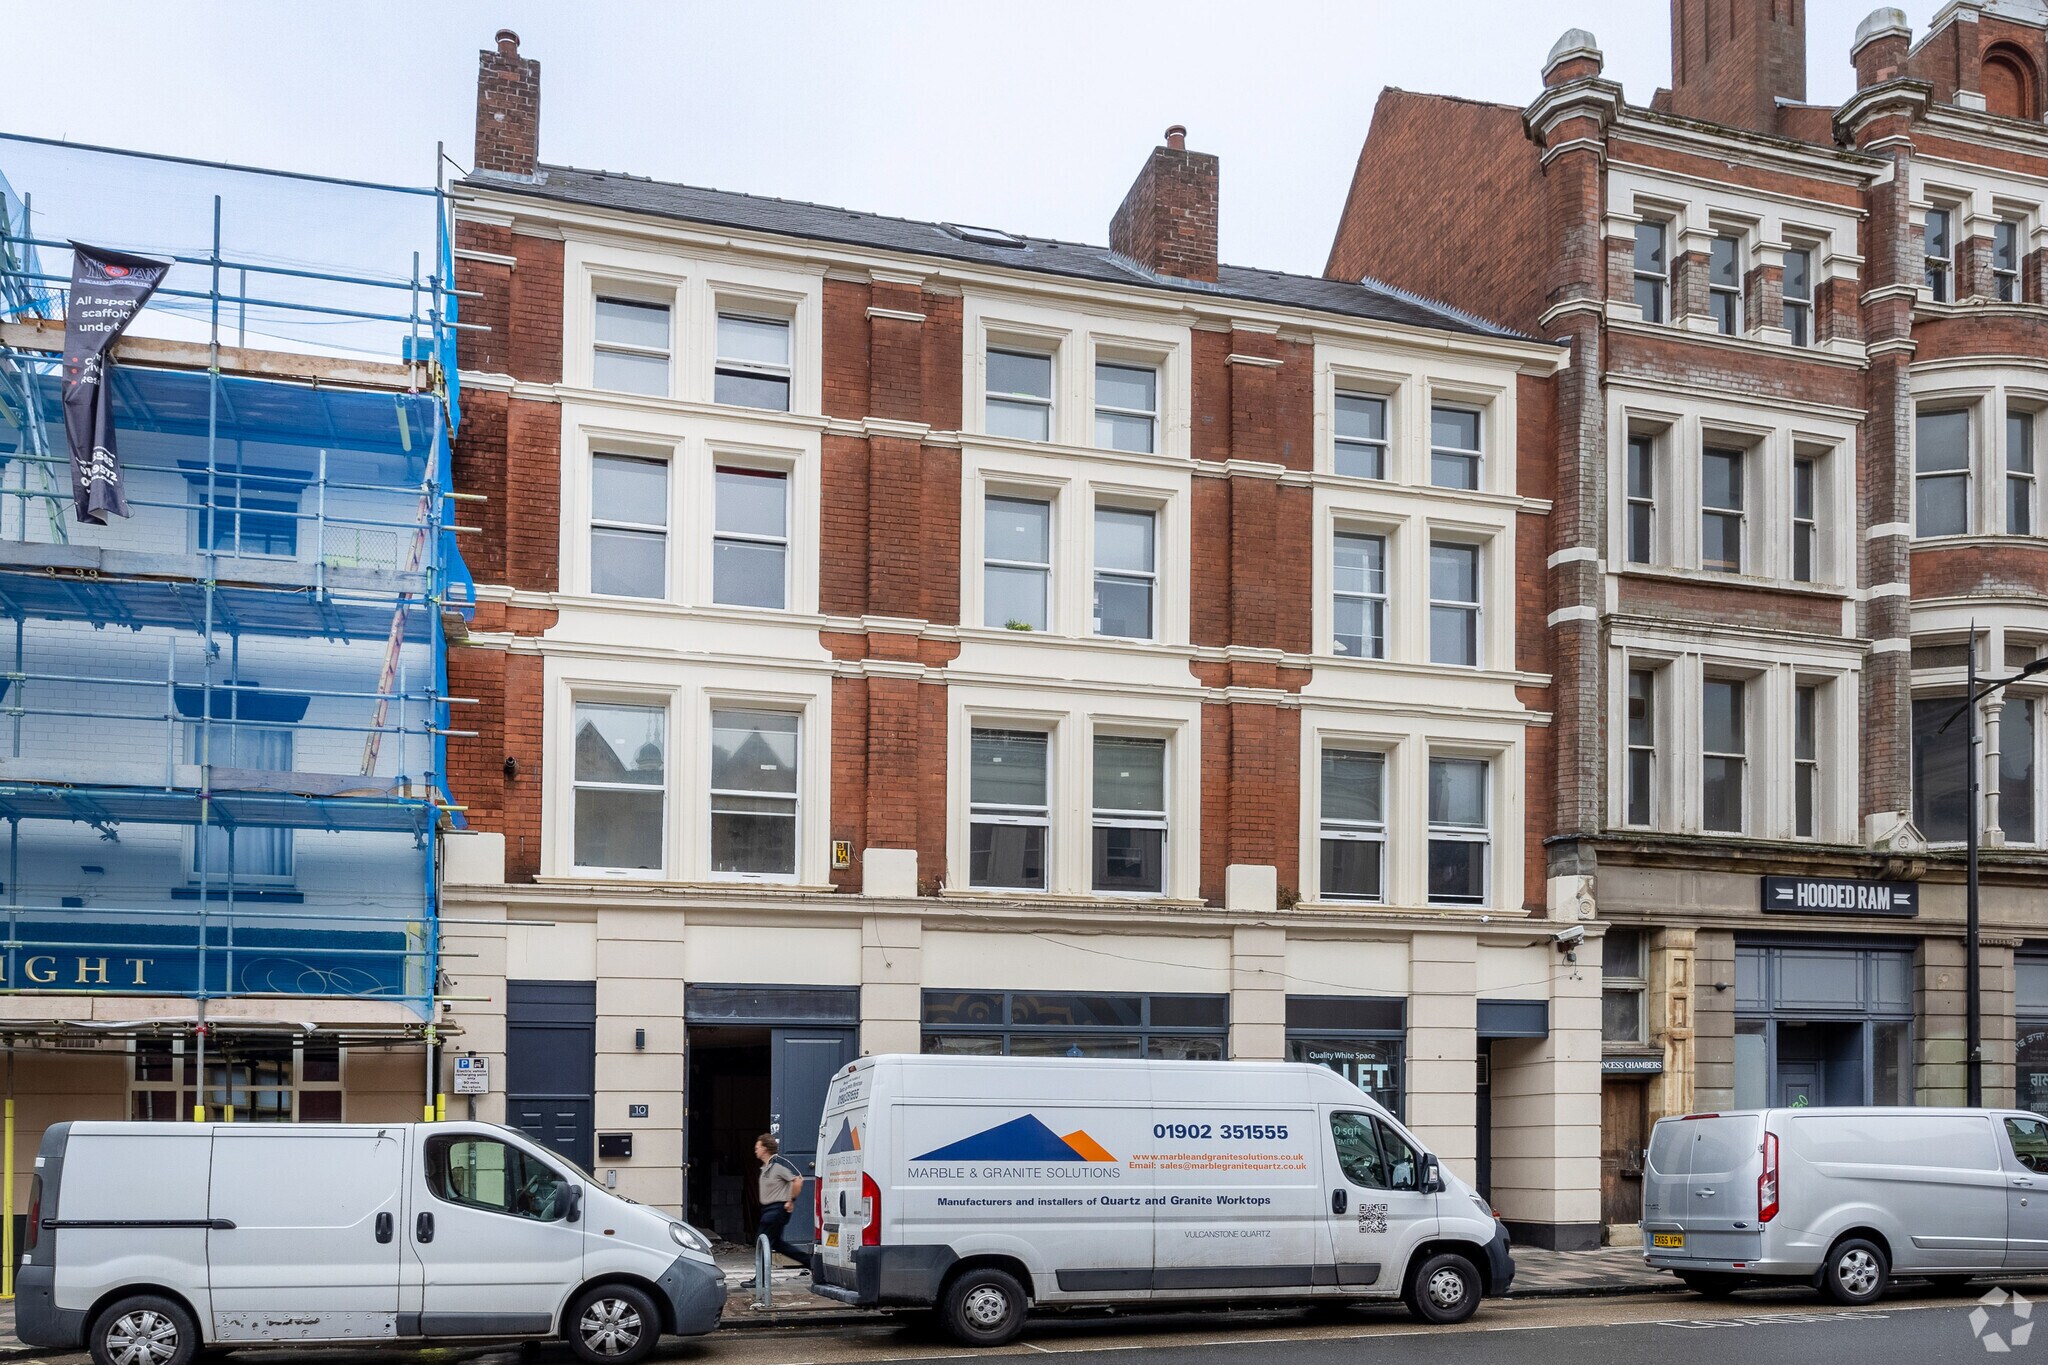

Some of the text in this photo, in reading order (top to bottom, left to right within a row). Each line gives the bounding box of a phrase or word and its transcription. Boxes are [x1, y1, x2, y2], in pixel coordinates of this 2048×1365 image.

[76, 296, 91, 305] All
[1797, 883, 1890, 910] HOODED RAM
[1309, 1051, 1333, 1060] Quality
[1355, 1052, 1376, 1060] Space
[634, 1106, 646, 1114] 10
[1153, 1124, 1289, 1140] 01902 351555
[1132, 1153, 1304, 1162] www.marbleandgranitesolutions.co.uk
[1160, 1162, 1307, 1171] sales@marblegranitequartz.co.uk
[908, 1167, 1120, 1178] MARBLE & GRANITE SOLUTIONS
[937, 1195, 1271, 1206] Manufacturers and installers of Quartz and Granite Worktops
[1184, 1230, 1271, 1238] VULCANSTONE QUARTZ
[1670, 1236, 1682, 1245] VPN
